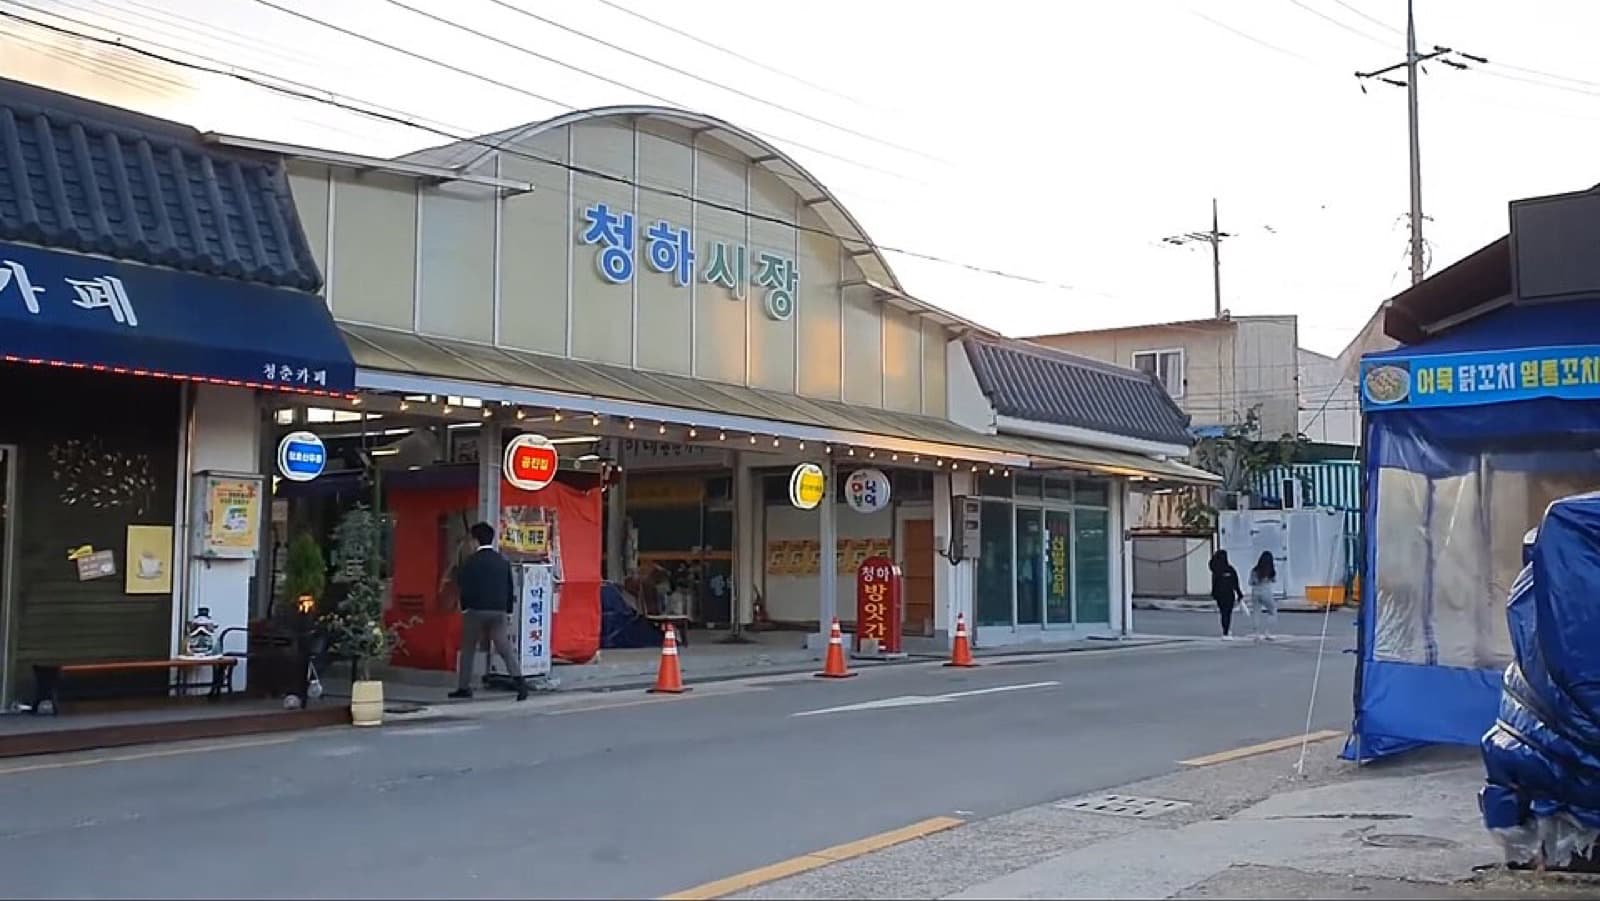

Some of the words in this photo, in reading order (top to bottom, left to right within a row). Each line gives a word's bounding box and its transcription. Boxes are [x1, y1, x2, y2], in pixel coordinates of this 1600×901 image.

[584, 203, 799, 321] 청하시장
[263, 363, 327, 387] 청춘카페
[1417, 367, 1453, 394] 어묵
[1458, 362, 1516, 392] 닭꼬치
[1520, 356, 1600, 388] 염통꼬치
[863, 584, 888, 641] 방앗간
